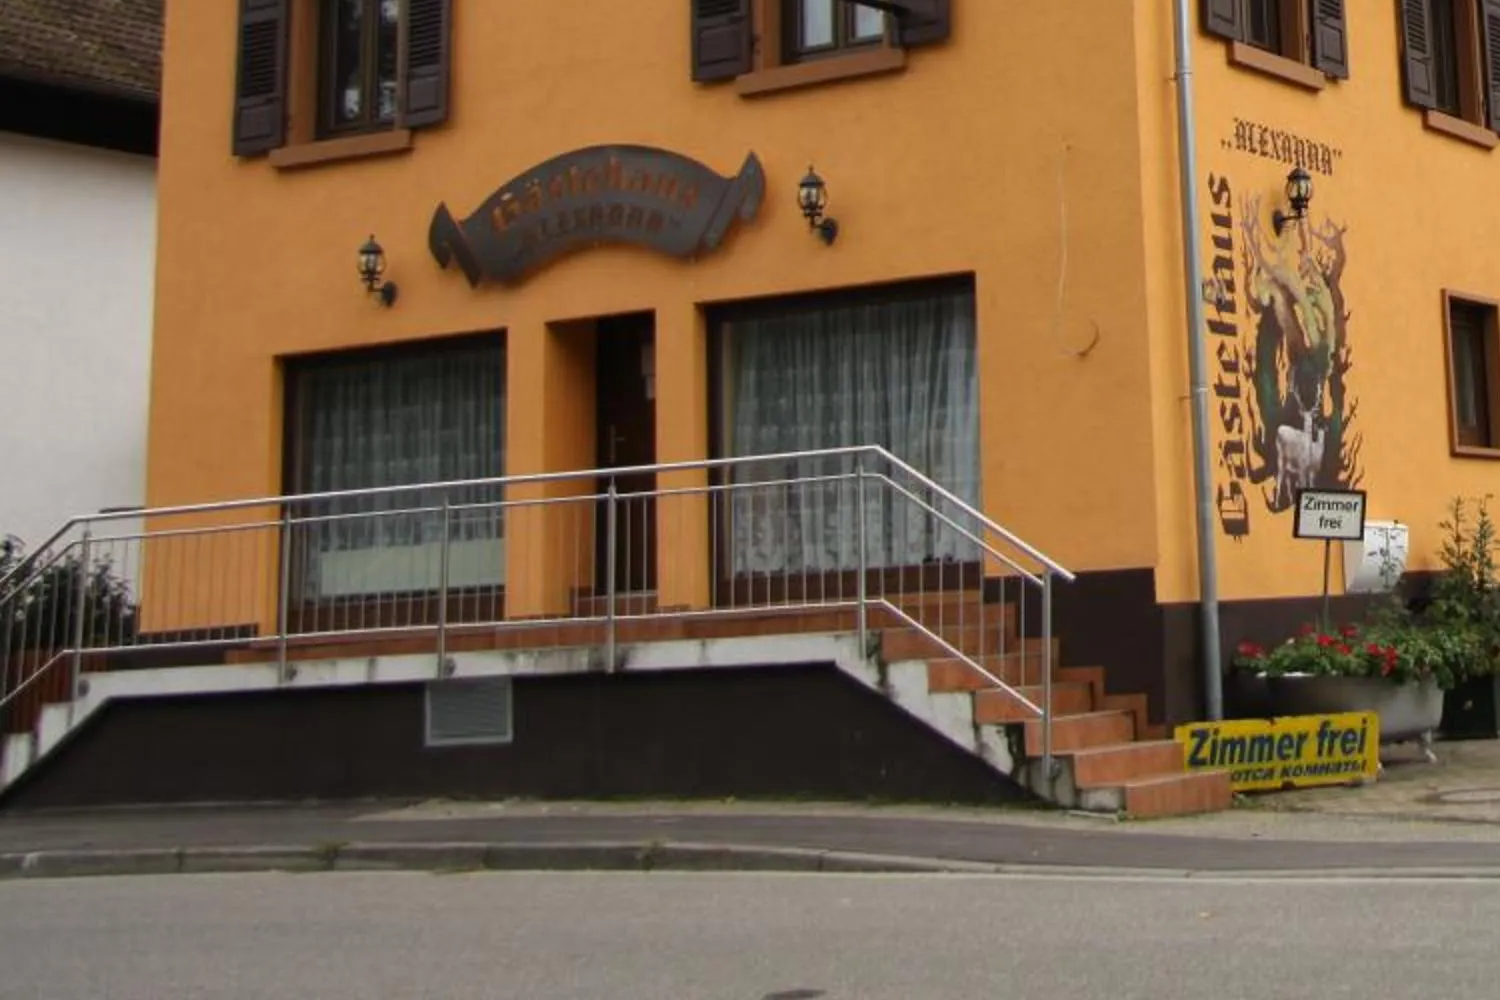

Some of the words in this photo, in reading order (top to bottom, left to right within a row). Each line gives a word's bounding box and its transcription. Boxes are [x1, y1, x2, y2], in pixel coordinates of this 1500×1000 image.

[1207, 171, 1250, 541] Gästehaus
[1303, 495, 1359, 512] Zimmer
[1318, 515, 1343, 529] frei
[1188, 727, 1308, 767] Zimmer
[1316, 717, 1368, 757] frei
